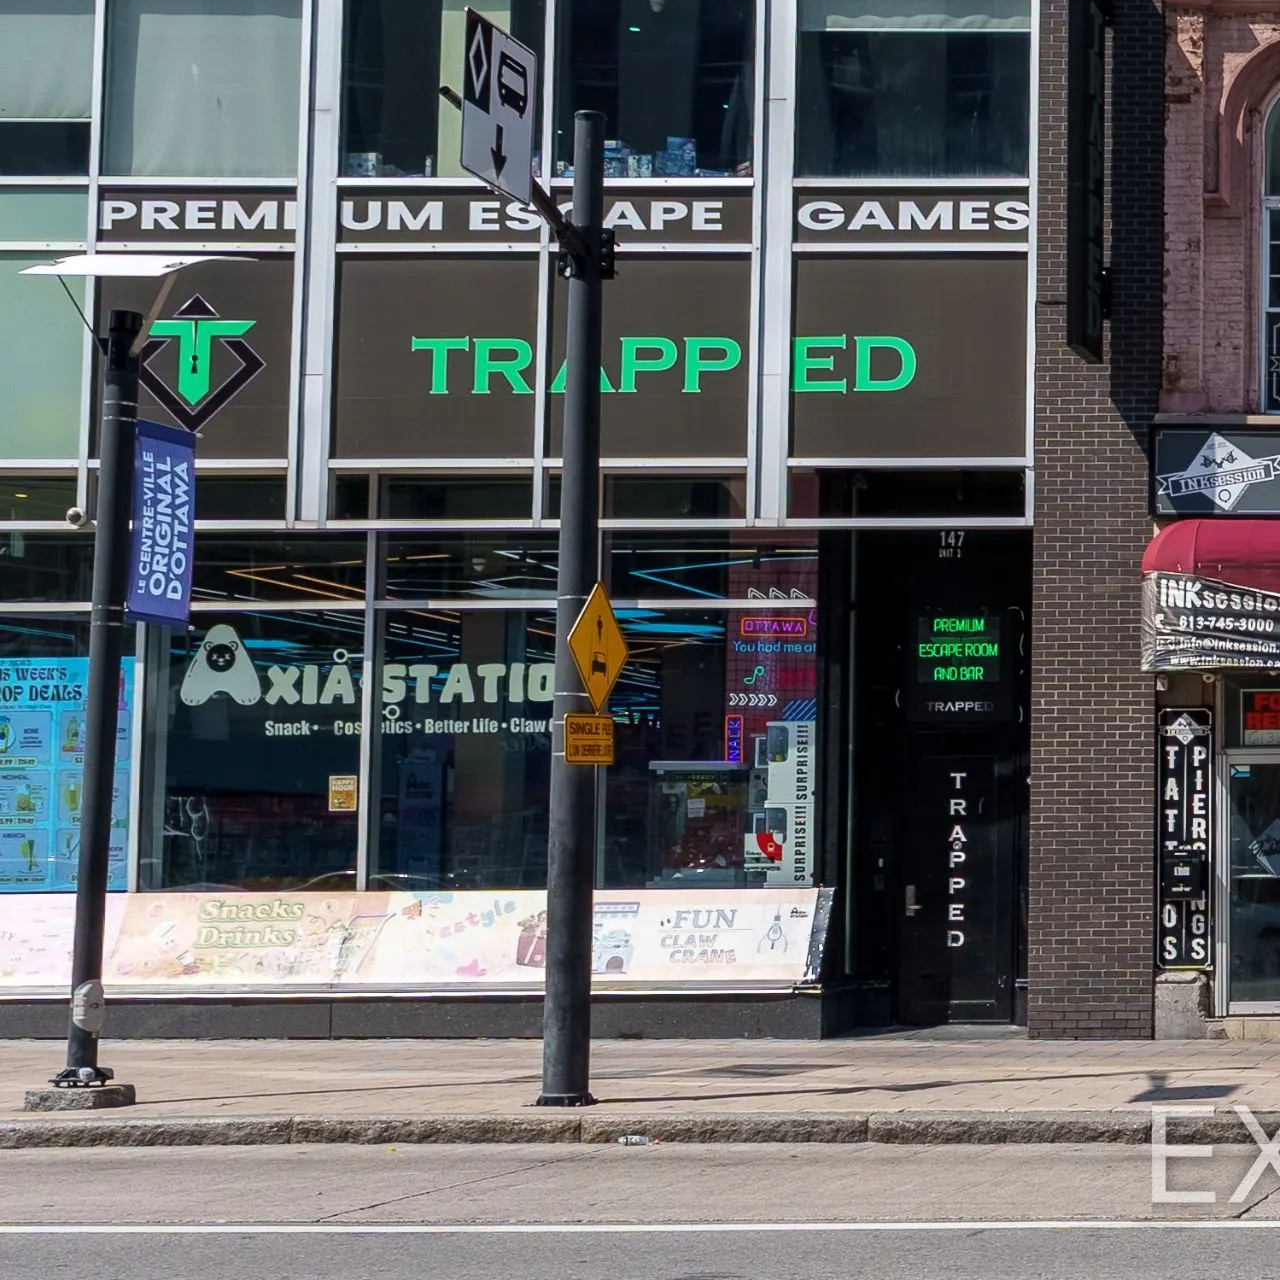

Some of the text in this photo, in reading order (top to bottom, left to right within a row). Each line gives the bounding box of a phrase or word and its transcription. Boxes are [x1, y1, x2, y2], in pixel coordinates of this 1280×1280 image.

[469, 200, 722, 231] ESAPE
[797, 200, 1030, 231] GAMES
[1179, 466, 1266, 493] INKsession
[137, 451, 155, 594] LE CENTRE-VILLE
[149, 456, 172, 596] ORIGINAL
[166, 462, 189, 600] D'OTTAWA
[940, 531, 965, 547] 147
[744, 621, 803, 632] OTTAWA
[933, 618, 985, 632] PREMIUM
[1179, 615, 1275, 632] 613-745-3000
[733, 641, 753, 653] You
[757, 641, 781, 653] had
[783, 644, 802, 653] me
[918, 643, 999, 658] ESCAPE ROOM
[15, 667, 68, 682] WEEK'S
[934, 667, 984, 681] AND BAR
[382, 662, 556, 705] STATIO
[0, 684, 83, 702] OP DEALS
[926, 701, 994, 712] TRAPPED
[265, 720, 311, 736] Snack
[334, 719, 413, 736] Costics
[425, 719, 470, 734] Better
[472, 718, 499, 734] Life
[510, 718, 546, 734] Claw
[569, 722, 600, 736] SINGLE
[728, 719, 742, 762] NACK
[947, 772, 967, 947] TRAPPED
[1164, 746, 1179, 960] TATOS
[1190, 746, 1207, 960] PIERNGS
[198, 898, 304, 923] Snacks
[672, 908, 738, 929] FUN
[193, 925, 299, 950] Drinks
[660, 935, 718, 949] CLAW
[669, 949, 737, 964] CRANE
